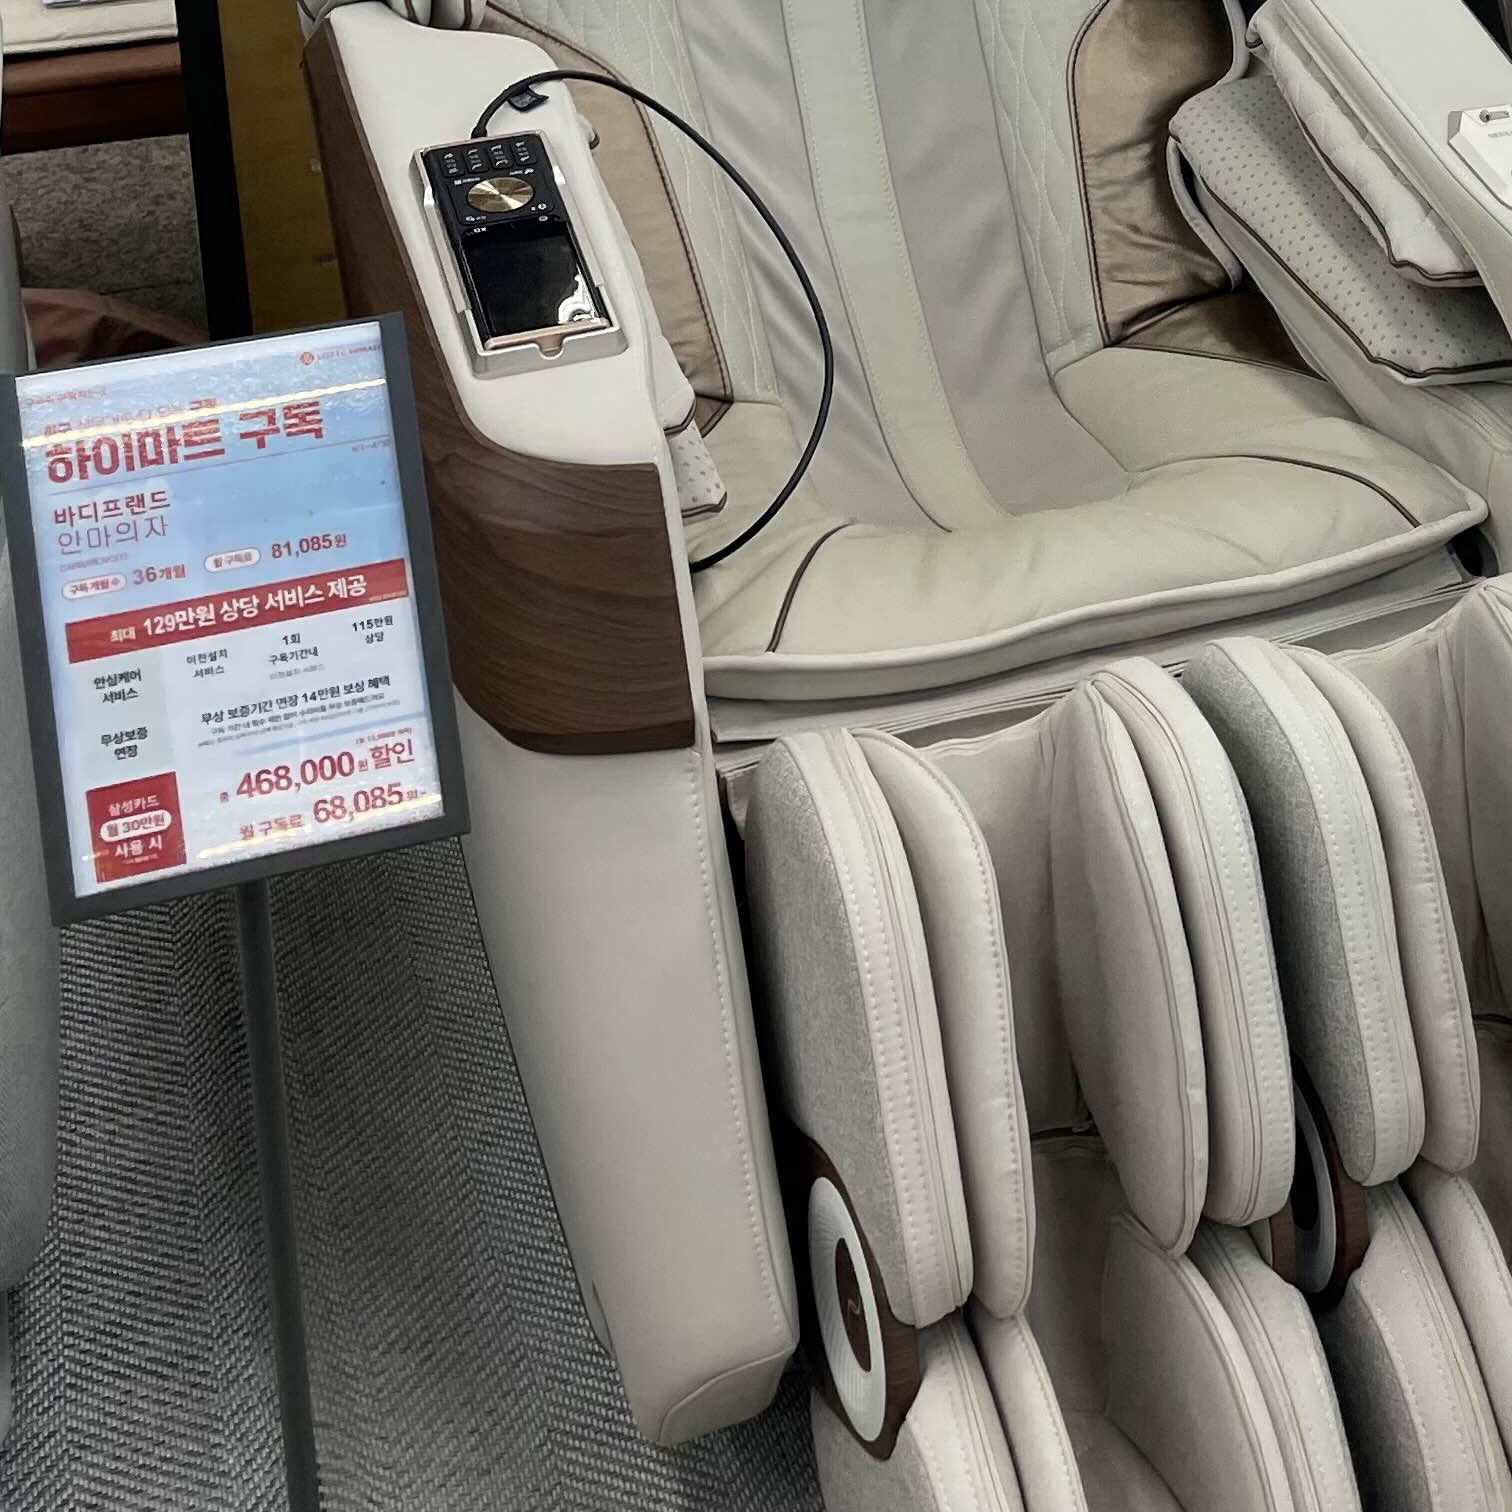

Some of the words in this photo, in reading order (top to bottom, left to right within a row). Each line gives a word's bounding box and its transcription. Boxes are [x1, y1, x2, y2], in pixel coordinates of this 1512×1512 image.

[44, 414, 225, 483] 하이마트
[239, 400, 324, 449] 구독
[54, 490, 172, 528] 바디프랜드
[57, 515, 169, 556] 안마의자
[132, 564, 186, 586] 36개월
[271, 533, 348, 560] 81,085원
[110, 627, 136, 643] 최대
[143, 605, 216, 638] 129만원
[219, 597, 260, 623] 상당
[264, 586, 325, 614] 서비스
[327, 574, 368, 601] 제공
[351, 614, 395, 633] 115만원
[281, 632, 302, 646] 1회
[363, 630, 385, 645] 상당
[93, 668, 142, 691] 안심케어
[193, 663, 225, 680] 서비스
[102, 685, 139, 705] 서비스
[200, 709, 225, 727] 무상
[226, 699, 274, 722] 보증기간
[275, 695, 300, 711] 연장
[300, 685, 341, 705] 14만원
[342, 679, 366, 696] 보상
[367, 673, 391, 690] 혜택
[100, 726, 148, 747] 무상보증
[113, 743, 139, 761] 연장
[235, 751, 369, 800] 468,000원
[369, 738, 416, 769] 할인
[108, 793, 161, 817] 삼성카드
[121, 812, 166, 834] 30만원
[113, 840, 145, 859] 사용
[147, 837, 164, 852] 시
